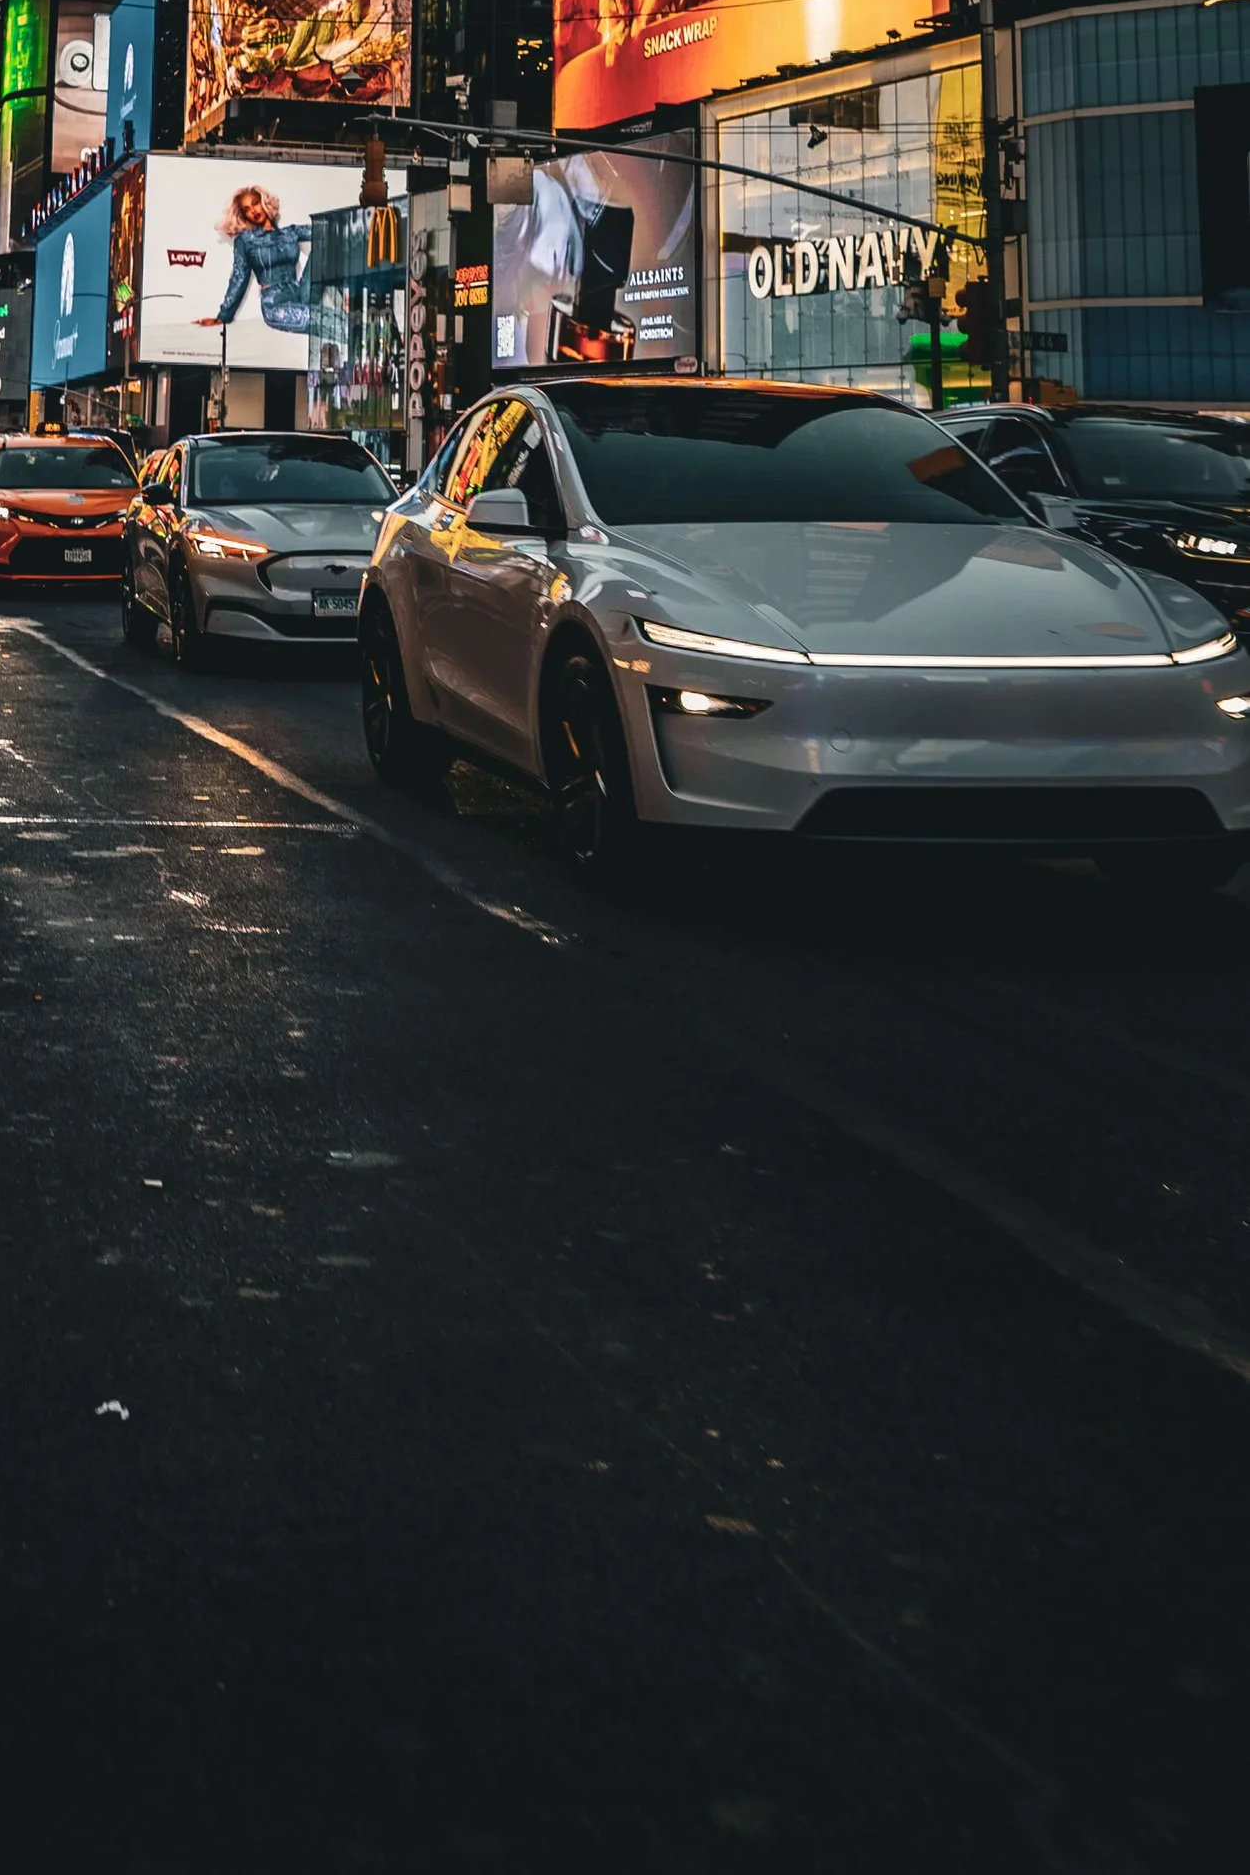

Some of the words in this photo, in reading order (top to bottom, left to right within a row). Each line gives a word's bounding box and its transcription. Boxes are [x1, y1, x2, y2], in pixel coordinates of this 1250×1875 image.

[643, 27, 682, 59] SNACK
[683, 16, 719, 46] WRAP
[748, 240, 819, 299] OLD
[828, 225, 939, 292] NAVY
[629, 266, 685, 287] ALLSAINTS
[641, 289, 660, 300] PARFUM
[659, 285, 690, 298] COLLECTION
[639, 328, 674, 341] NORDSTROM
